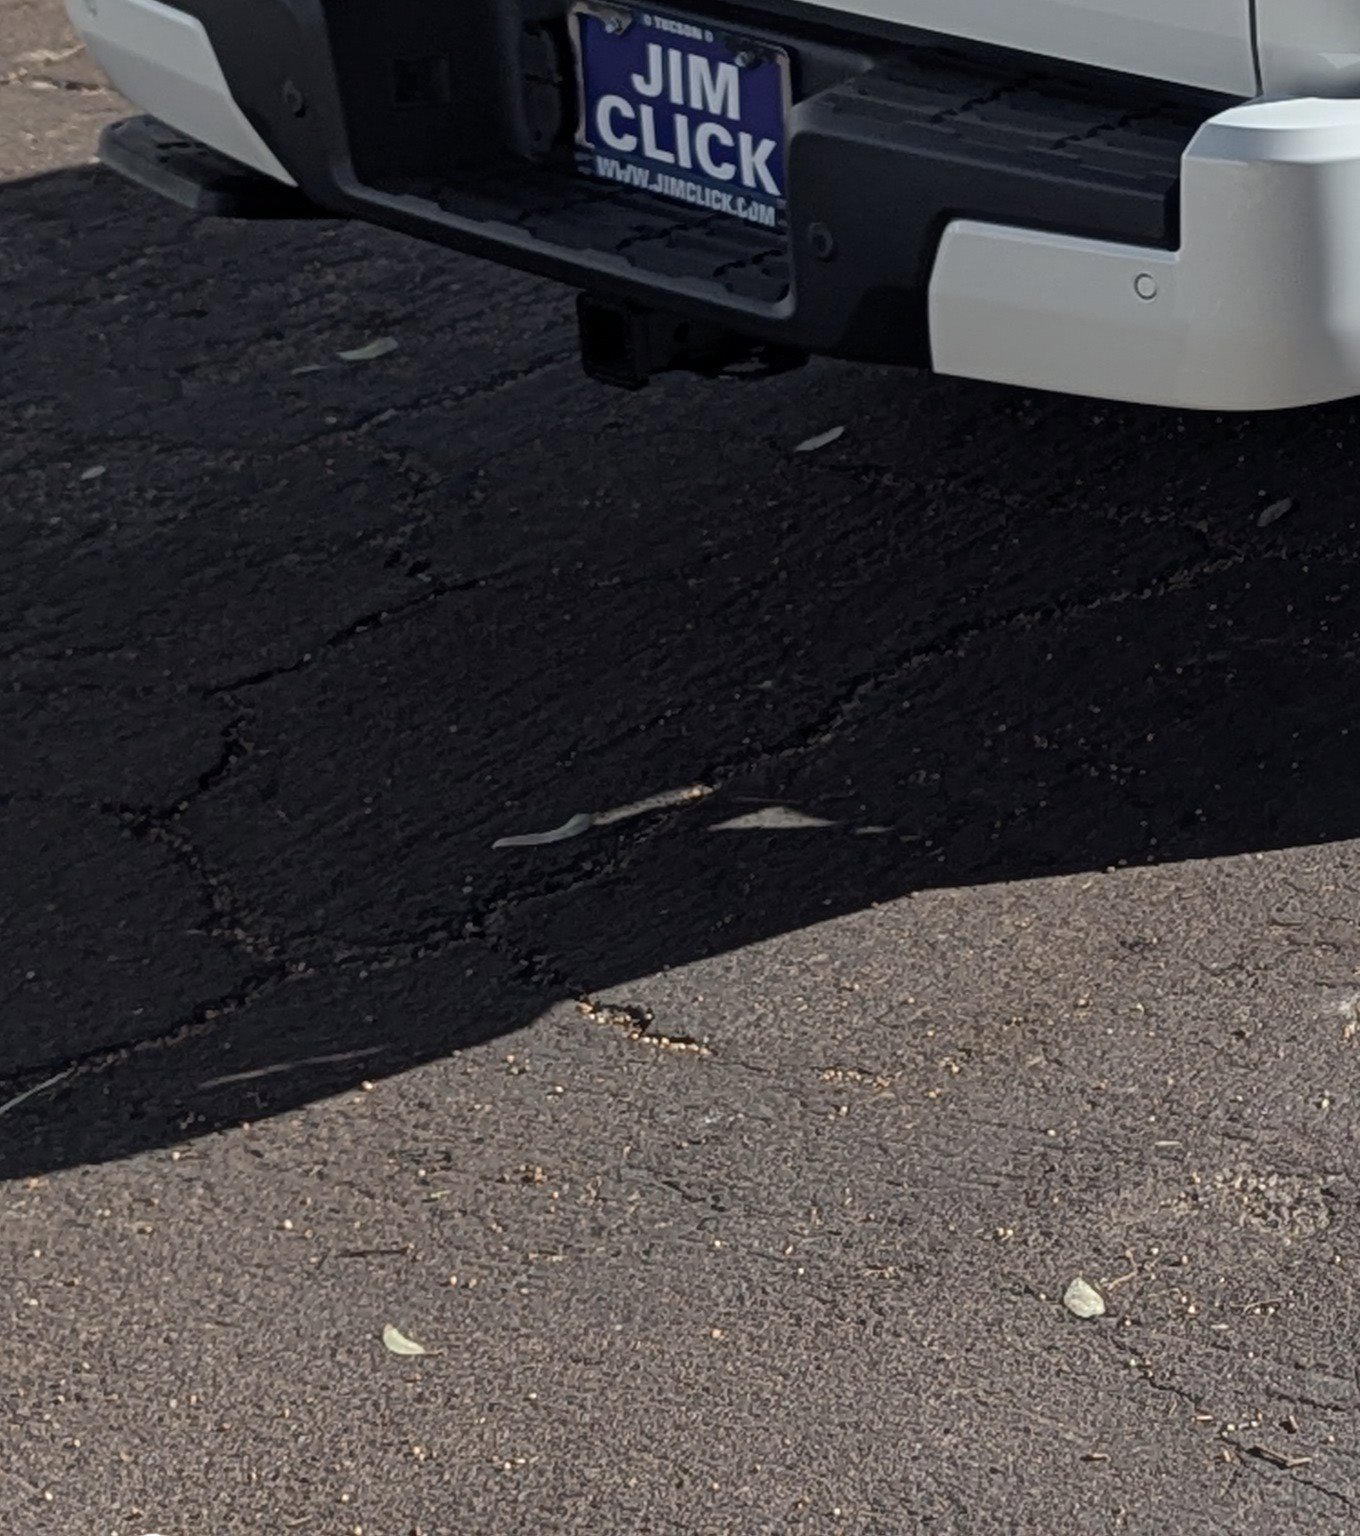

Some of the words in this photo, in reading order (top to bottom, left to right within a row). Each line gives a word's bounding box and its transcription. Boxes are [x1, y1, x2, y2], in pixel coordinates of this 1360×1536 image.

[653, 16, 703, 40] TUCSON
[630, 42, 741, 120] JIM
[595, 94, 782, 196] CLICK
[595, 155, 777, 227] WWW.JIMCLICK.COM
